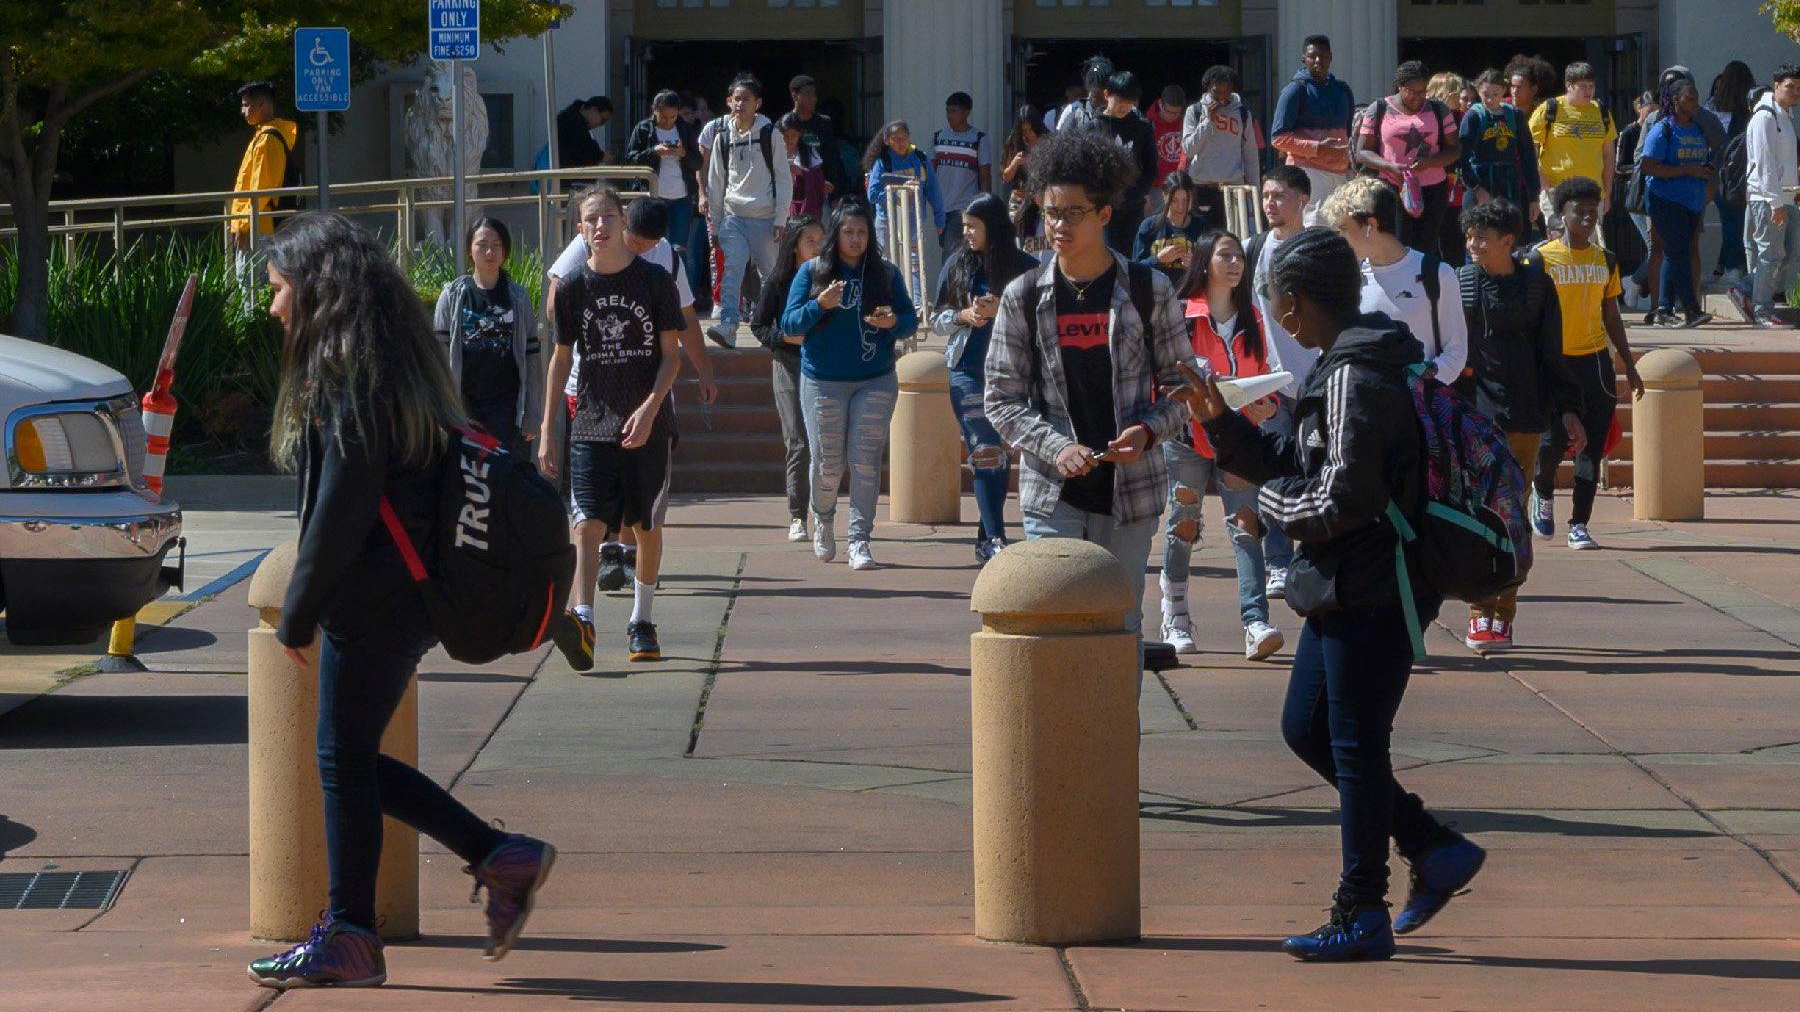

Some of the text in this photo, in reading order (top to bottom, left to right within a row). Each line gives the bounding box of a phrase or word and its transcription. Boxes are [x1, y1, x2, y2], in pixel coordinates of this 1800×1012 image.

[441, 11, 466, 27] ONLY
[438, 32, 469, 43] MINIMUM
[434, 45, 475, 56] FINE $250
[304, 68, 341, 76] PARKING
[298, 93, 348, 101] ACCESSIBLE
[595, 294, 654, 346] RELIGION
[619, 349, 652, 357] BRAND
[455, 452, 491, 550] TRUE
